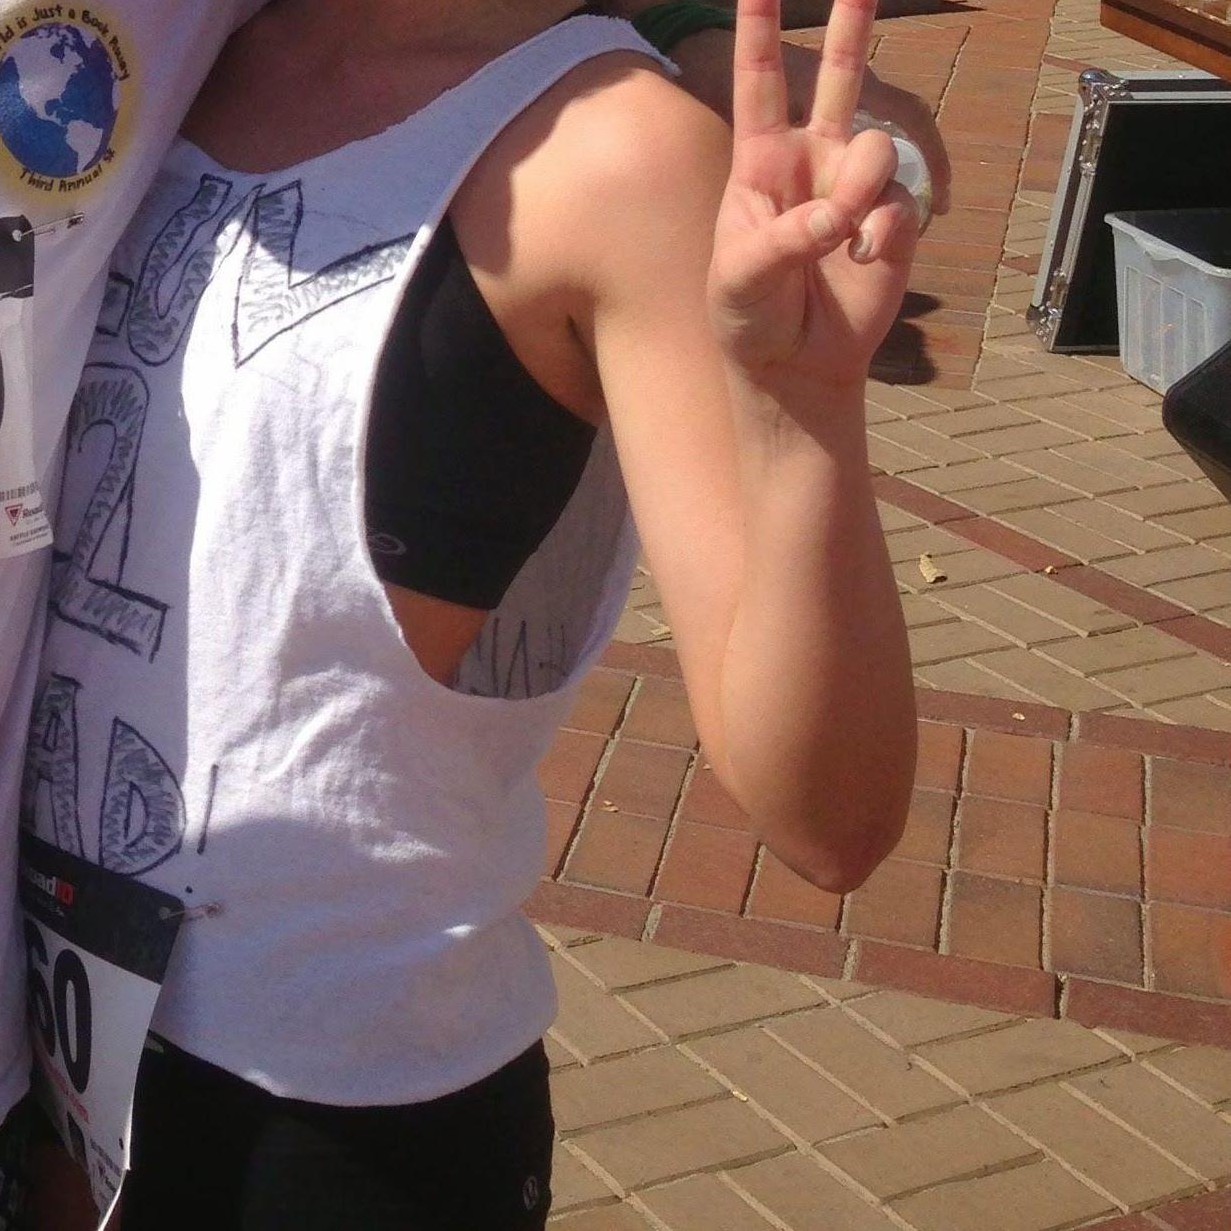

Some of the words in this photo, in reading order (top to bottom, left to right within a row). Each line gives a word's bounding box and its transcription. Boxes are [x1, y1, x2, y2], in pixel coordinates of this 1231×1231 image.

[15, 16, 28, 29] is
[32, 3, 63, 21] Just
[68, 9, 76, 20] a
[19, 167, 54, 191] Third
[58, 163, 103, 192] Annual
